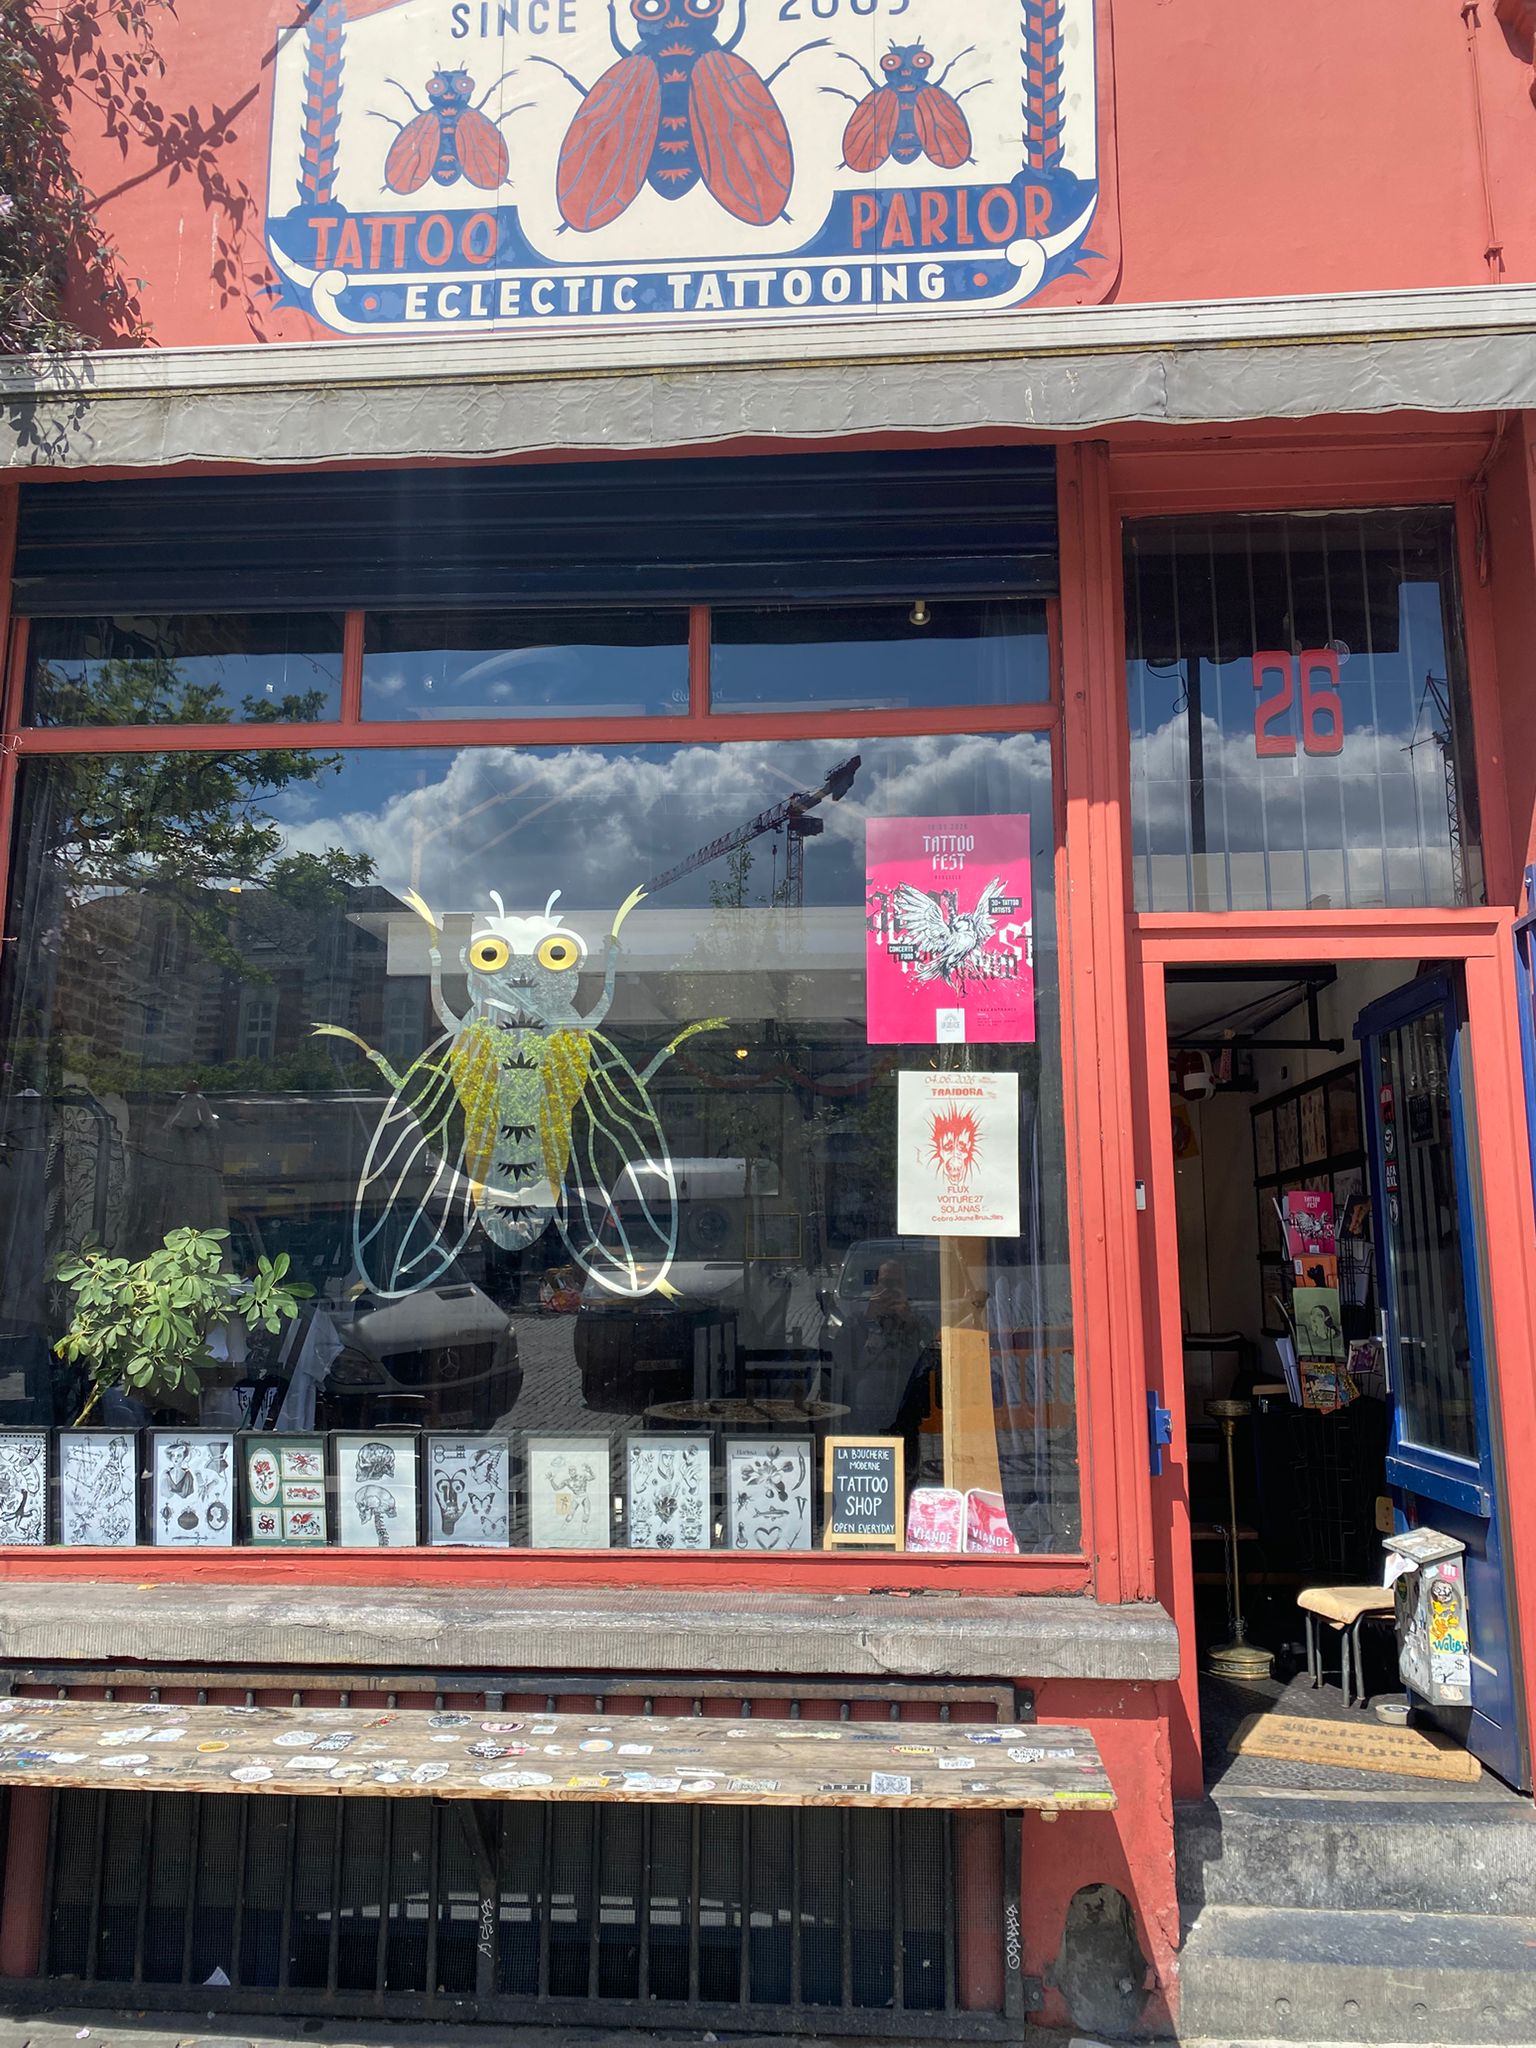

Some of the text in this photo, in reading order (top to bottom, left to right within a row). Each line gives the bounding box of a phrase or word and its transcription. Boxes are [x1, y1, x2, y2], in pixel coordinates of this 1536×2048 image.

[451, 0, 577, 38] SINCE
[308, 184, 1055, 270] TATTOO PARLOR
[404, 262, 947, 322] ECLECTIC TATTOOING
[1252, 648, 1345, 758] 26
[922, 835, 975, 852] TATTOO
[932, 853, 966, 871] FEST
[931, 1088, 984, 1097] TRAIDORA
[947, 1186, 970, 1194] FLUX
[937, 1195, 974, 1204] VOITURE
[940, 1204, 981, 1213] SOLANAS
[838, 1449, 890, 1460] LA BOUCHERIE
[849, 1461, 881, 1471] MODERNE
[837, 1475, 889, 1494] TATTOO
[844, 1495, 883, 1517] SHOP
[833, 1522, 895, 1534] OPEN EVERYDAY
[912, 1525, 953, 1545] VIANDE
[971, 1526, 1009, 1547] VIANDE
